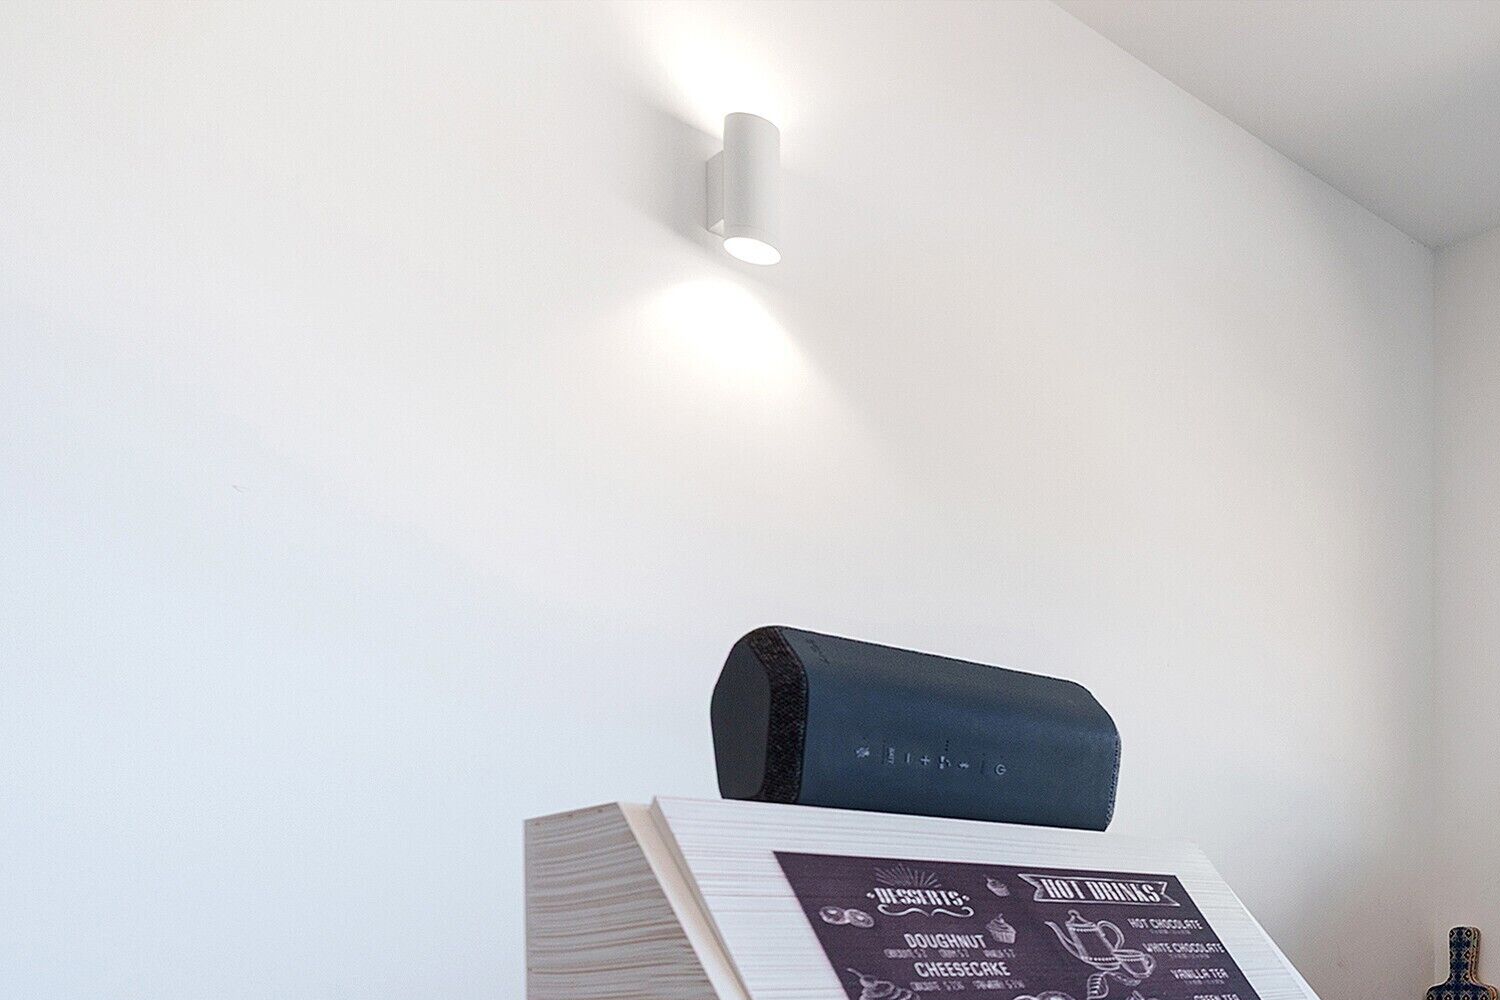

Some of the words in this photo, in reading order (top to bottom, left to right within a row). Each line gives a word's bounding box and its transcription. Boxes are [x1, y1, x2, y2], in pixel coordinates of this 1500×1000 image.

[874, 887, 963, 906] DESSERTS
[1040, 879, 1085, 899] HOT
[1086, 881, 1160, 902] DRINKS
[1128, 918, 1149, 928] HOT
[1150, 919, 1203, 930] CHOCOLATE
[904, 933, 987, 949] DOUGHNUT
[1142, 943, 1172, 953] WHITE
[1172, 943, 1226, 954] CHOCOLATE
[914, 961, 1011, 977] CHEESECAKE
[1170, 968, 1208, 979] VANILLA
[1208, 968, 1229, 979] TEA
